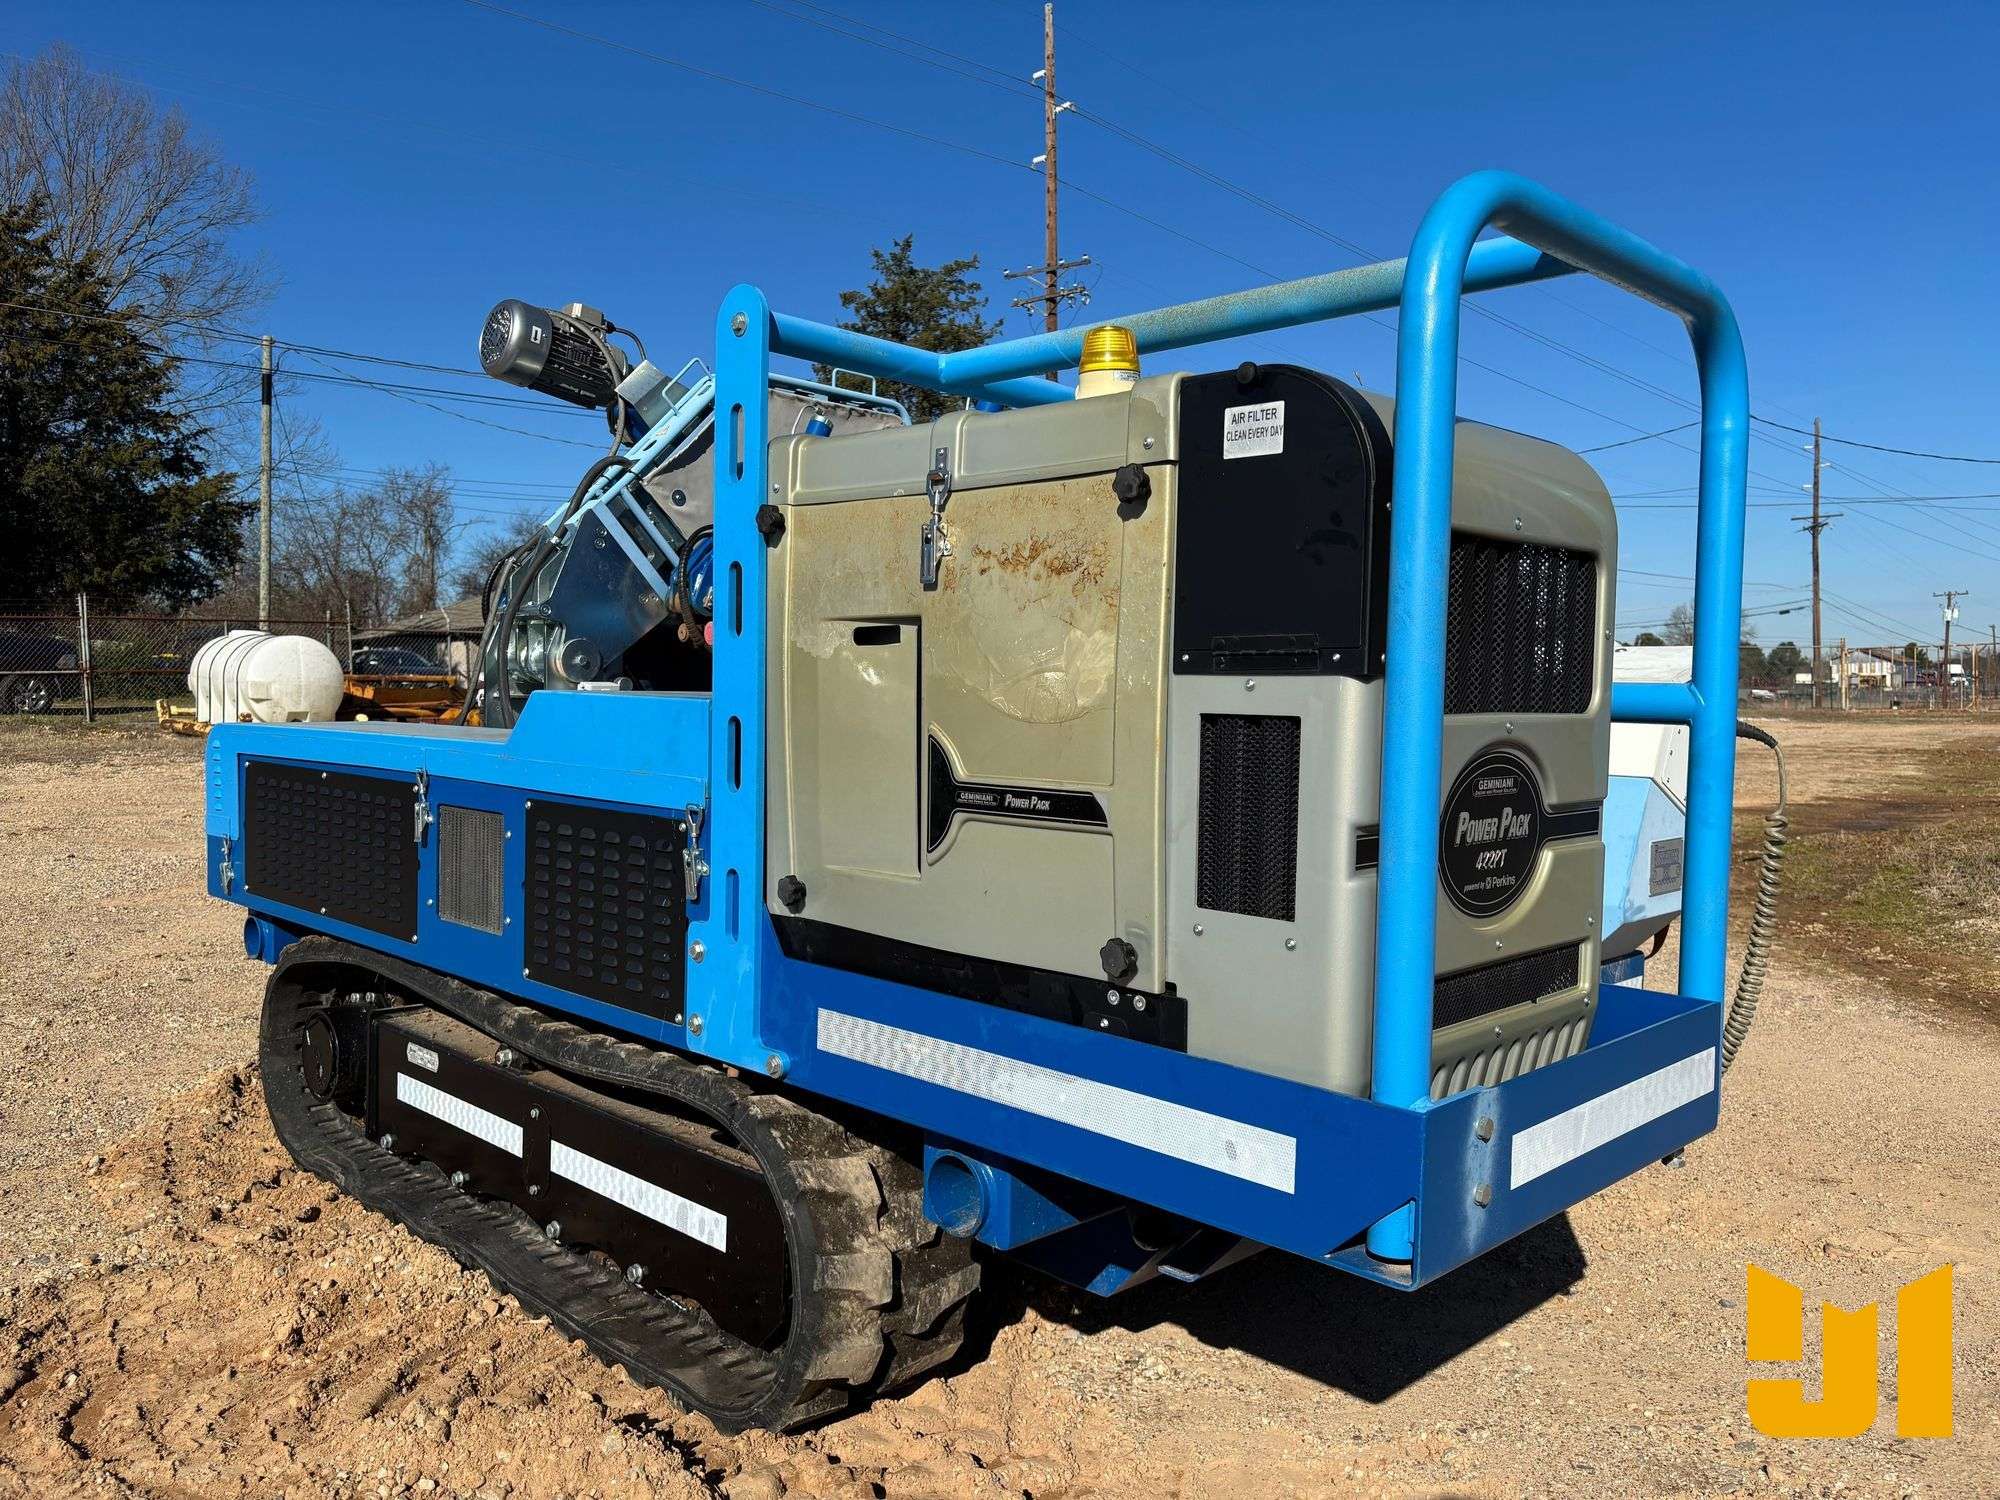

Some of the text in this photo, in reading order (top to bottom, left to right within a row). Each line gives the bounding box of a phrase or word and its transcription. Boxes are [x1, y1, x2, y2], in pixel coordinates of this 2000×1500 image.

[1231, 407, 1278, 425] AIR FILTER
[1226, 424, 1283, 442] CLEAN EVERY DAY
[1478, 778, 1514, 790] GEMINIANI
[1492, 874, 1516, 889] Perkins
